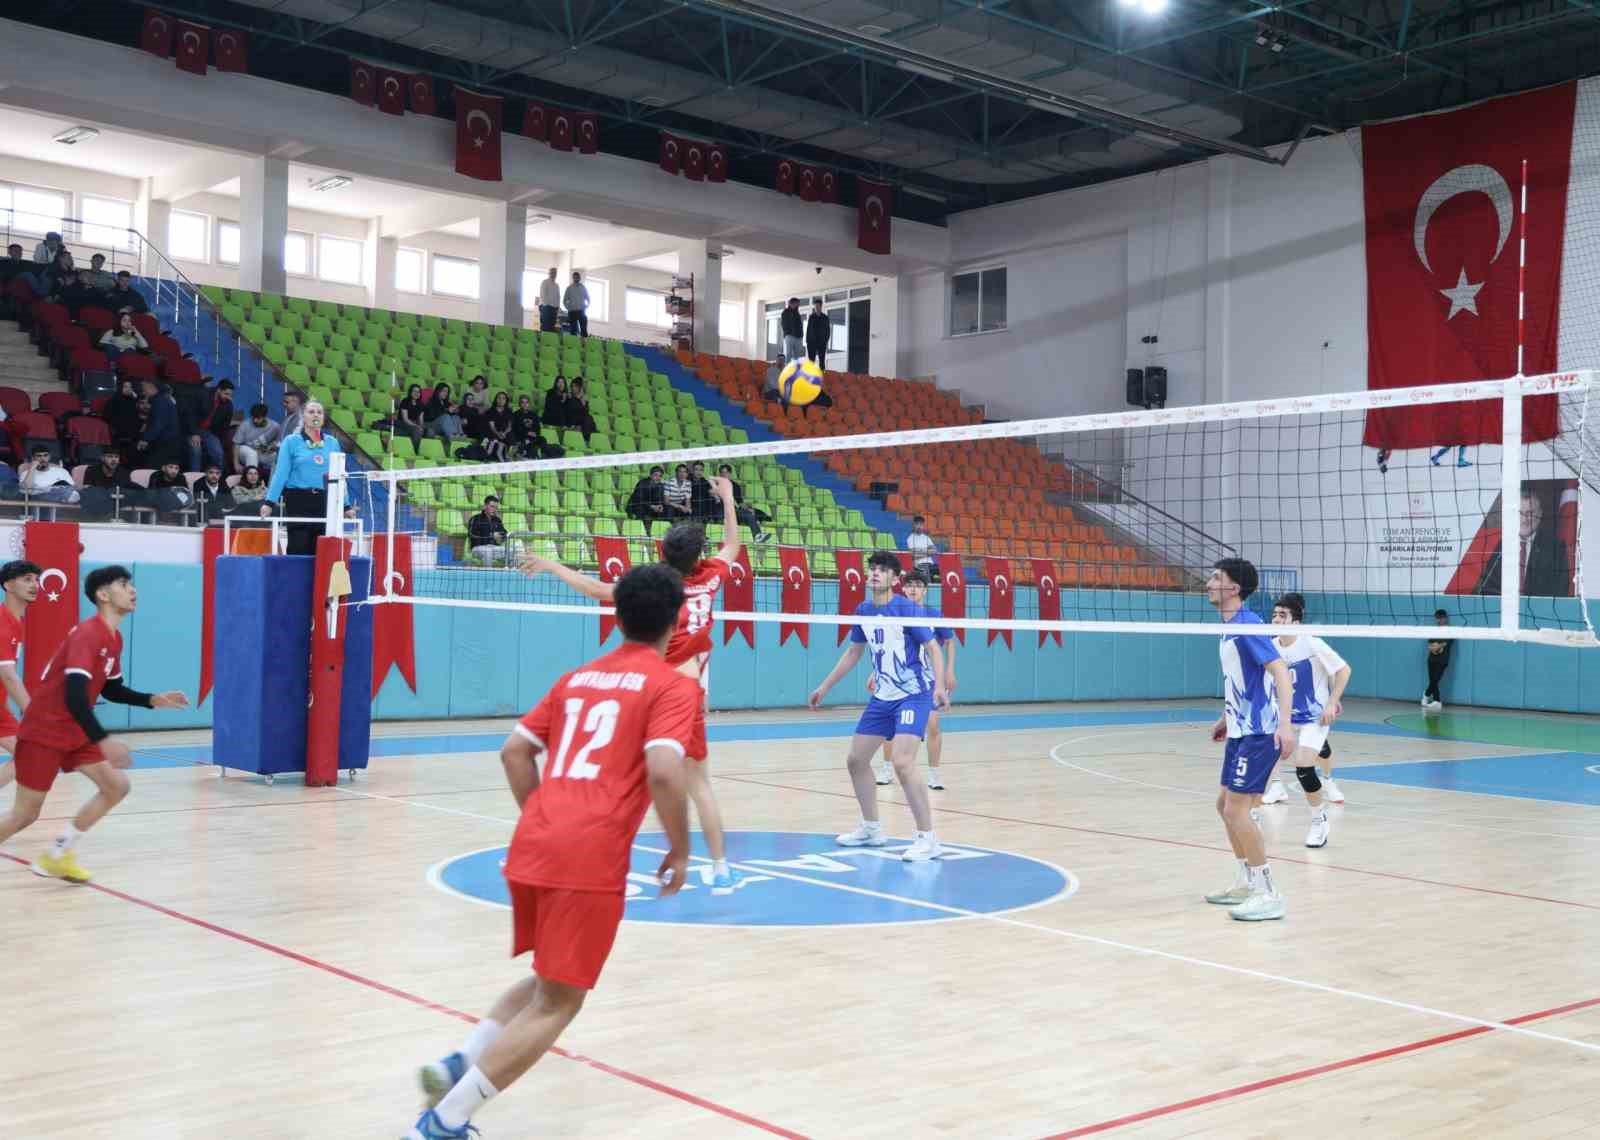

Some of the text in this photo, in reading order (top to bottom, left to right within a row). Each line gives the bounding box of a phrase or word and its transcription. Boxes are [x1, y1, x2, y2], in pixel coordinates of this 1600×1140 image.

[900, 709, 915, 725] 10
[551, 698, 621, 780] 12
[1235, 757, 1249, 776] 5
